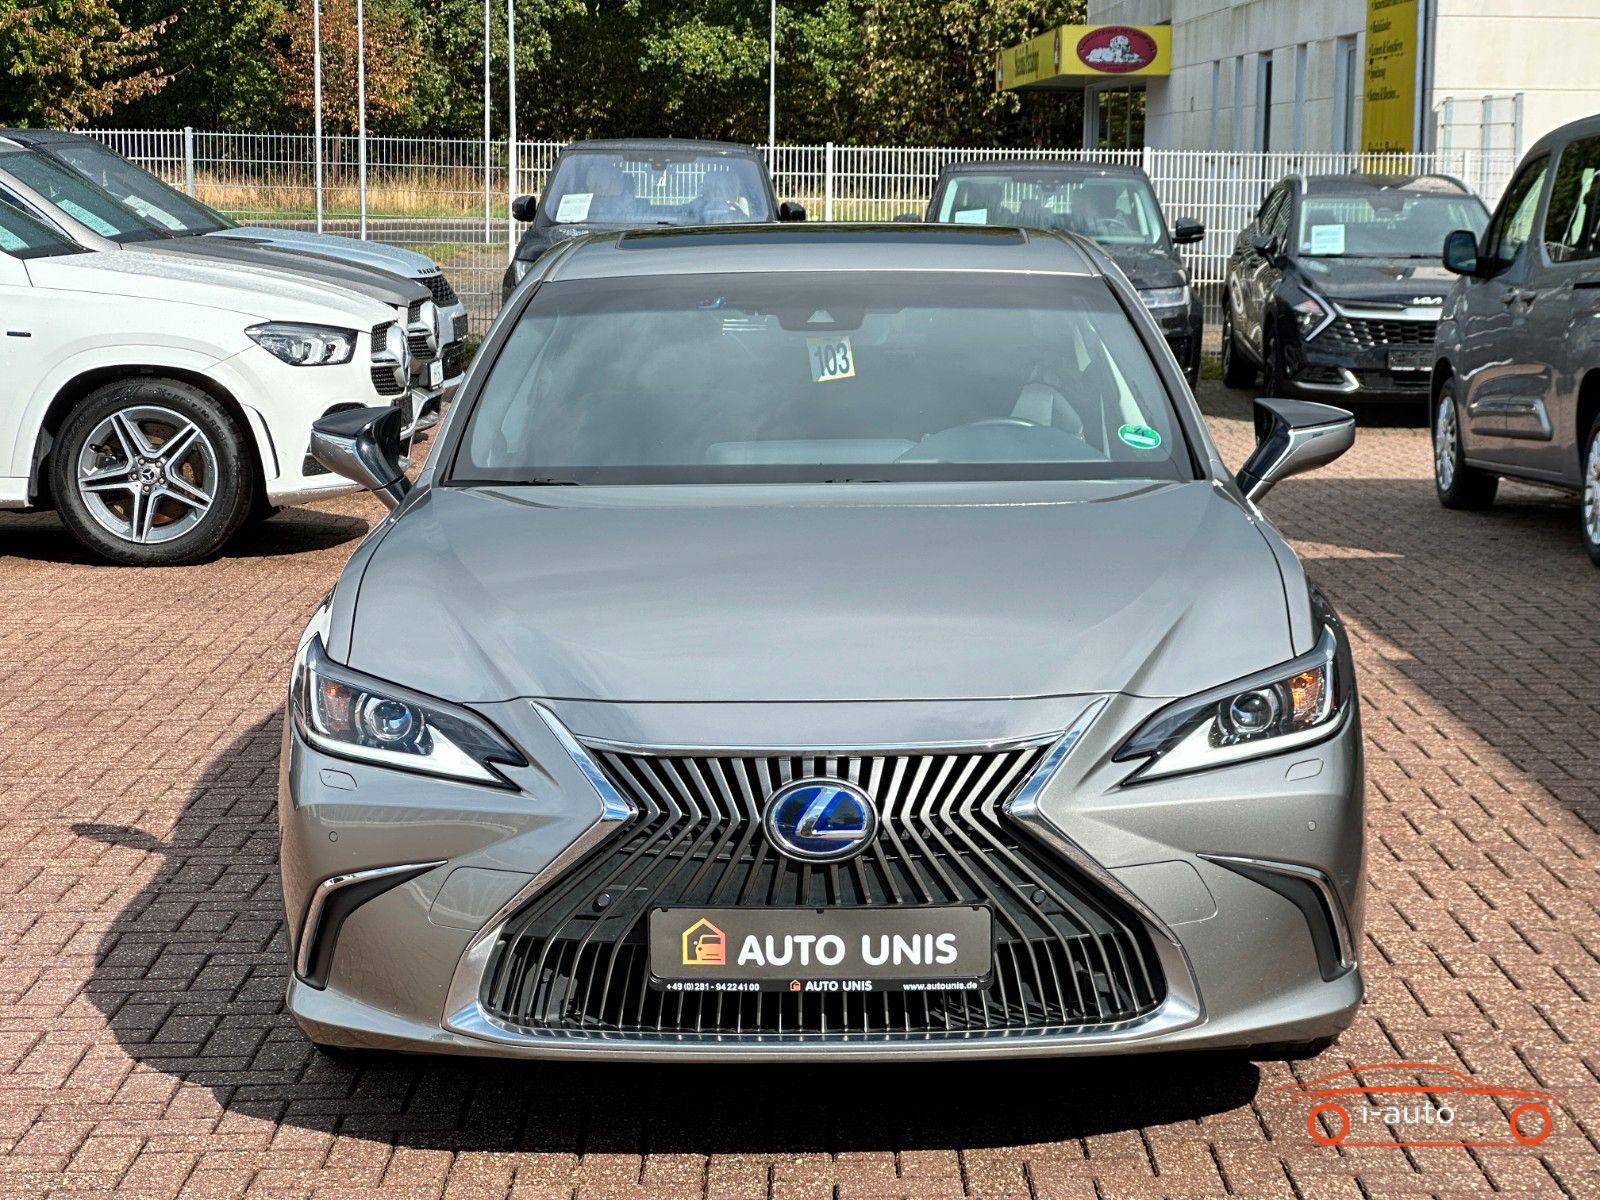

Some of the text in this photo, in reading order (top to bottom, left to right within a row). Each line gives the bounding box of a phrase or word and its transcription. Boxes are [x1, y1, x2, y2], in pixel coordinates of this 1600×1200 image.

[814, 342, 850, 377] 103
[737, 933, 958, 967] AUTO UNIS
[805, 980, 873, 992] AUTO UNIS
[903, 981, 978, 991] www.autounis.de
